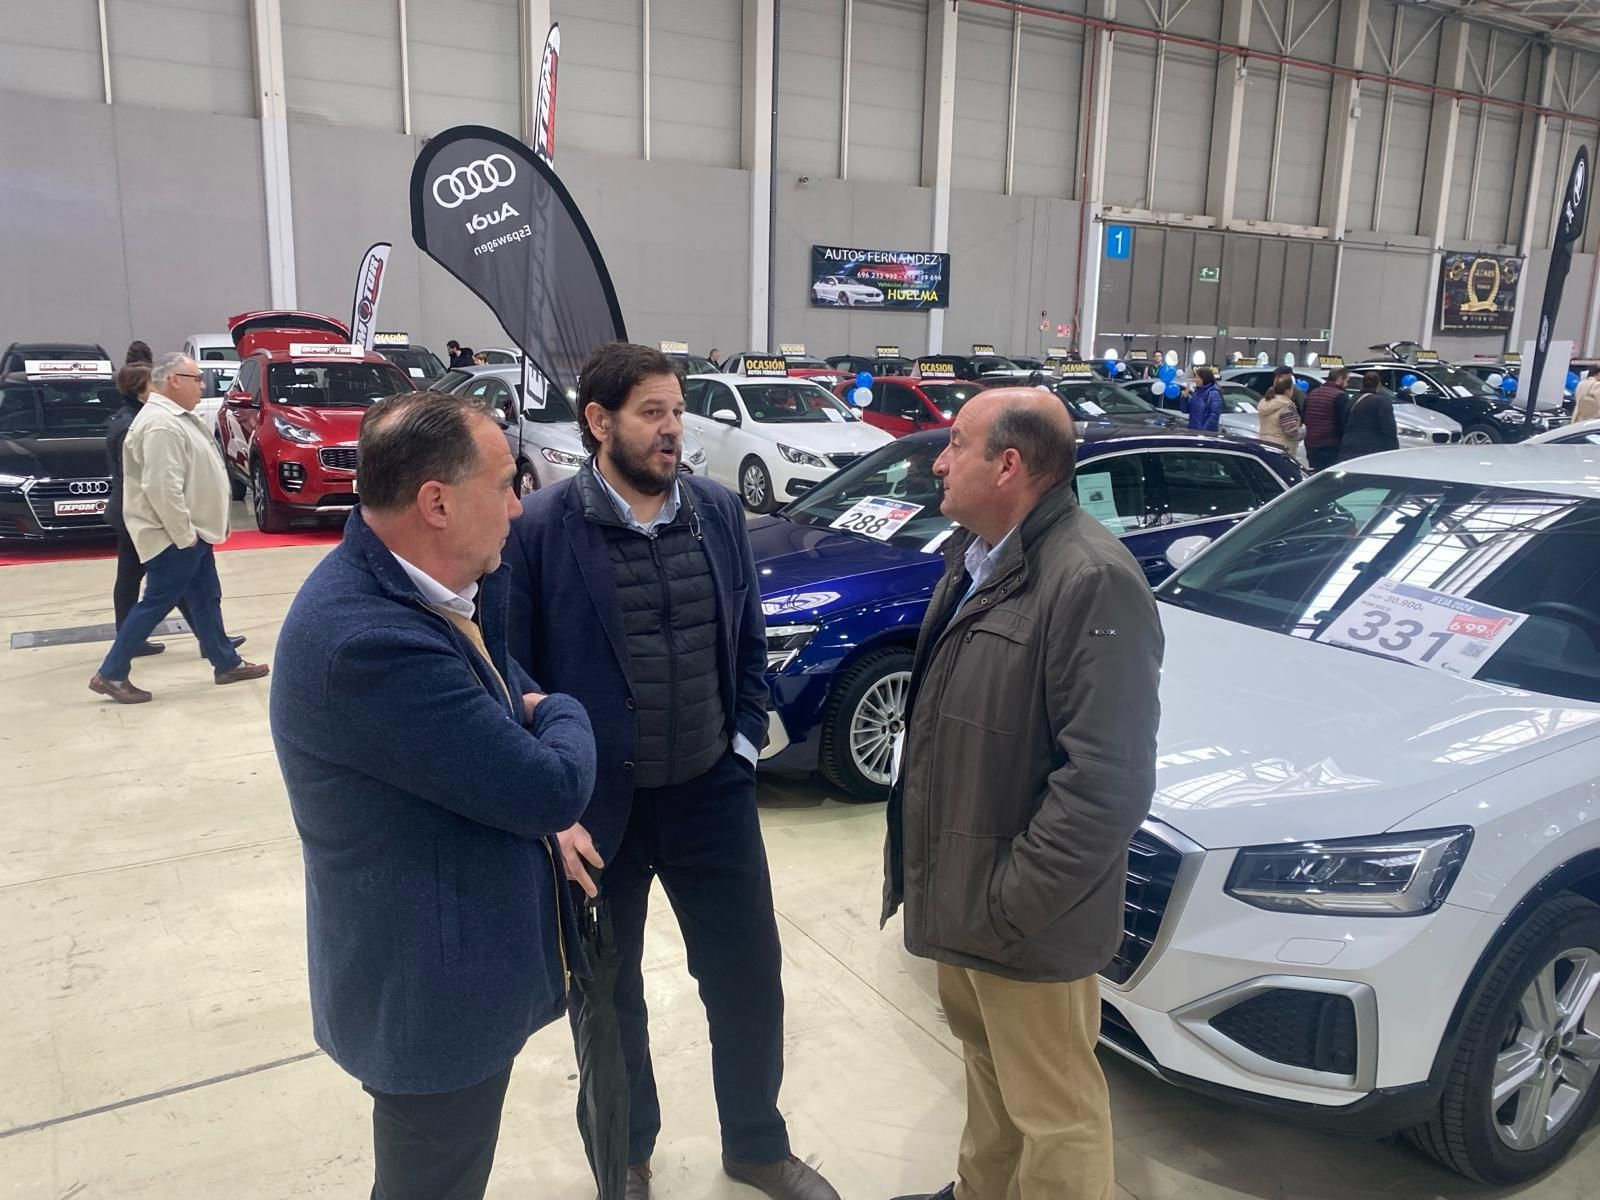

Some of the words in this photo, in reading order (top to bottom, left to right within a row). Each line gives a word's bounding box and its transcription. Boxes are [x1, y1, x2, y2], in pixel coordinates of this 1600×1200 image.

[1113, 231, 1124, 254] 1
[824, 248, 866, 261] AUTOS
[887, 288, 939, 301] HUELMA
[746, 358, 785, 370] OCASIÓN
[839, 512, 889, 534] 288
[1347, 610, 1455, 663] 331
